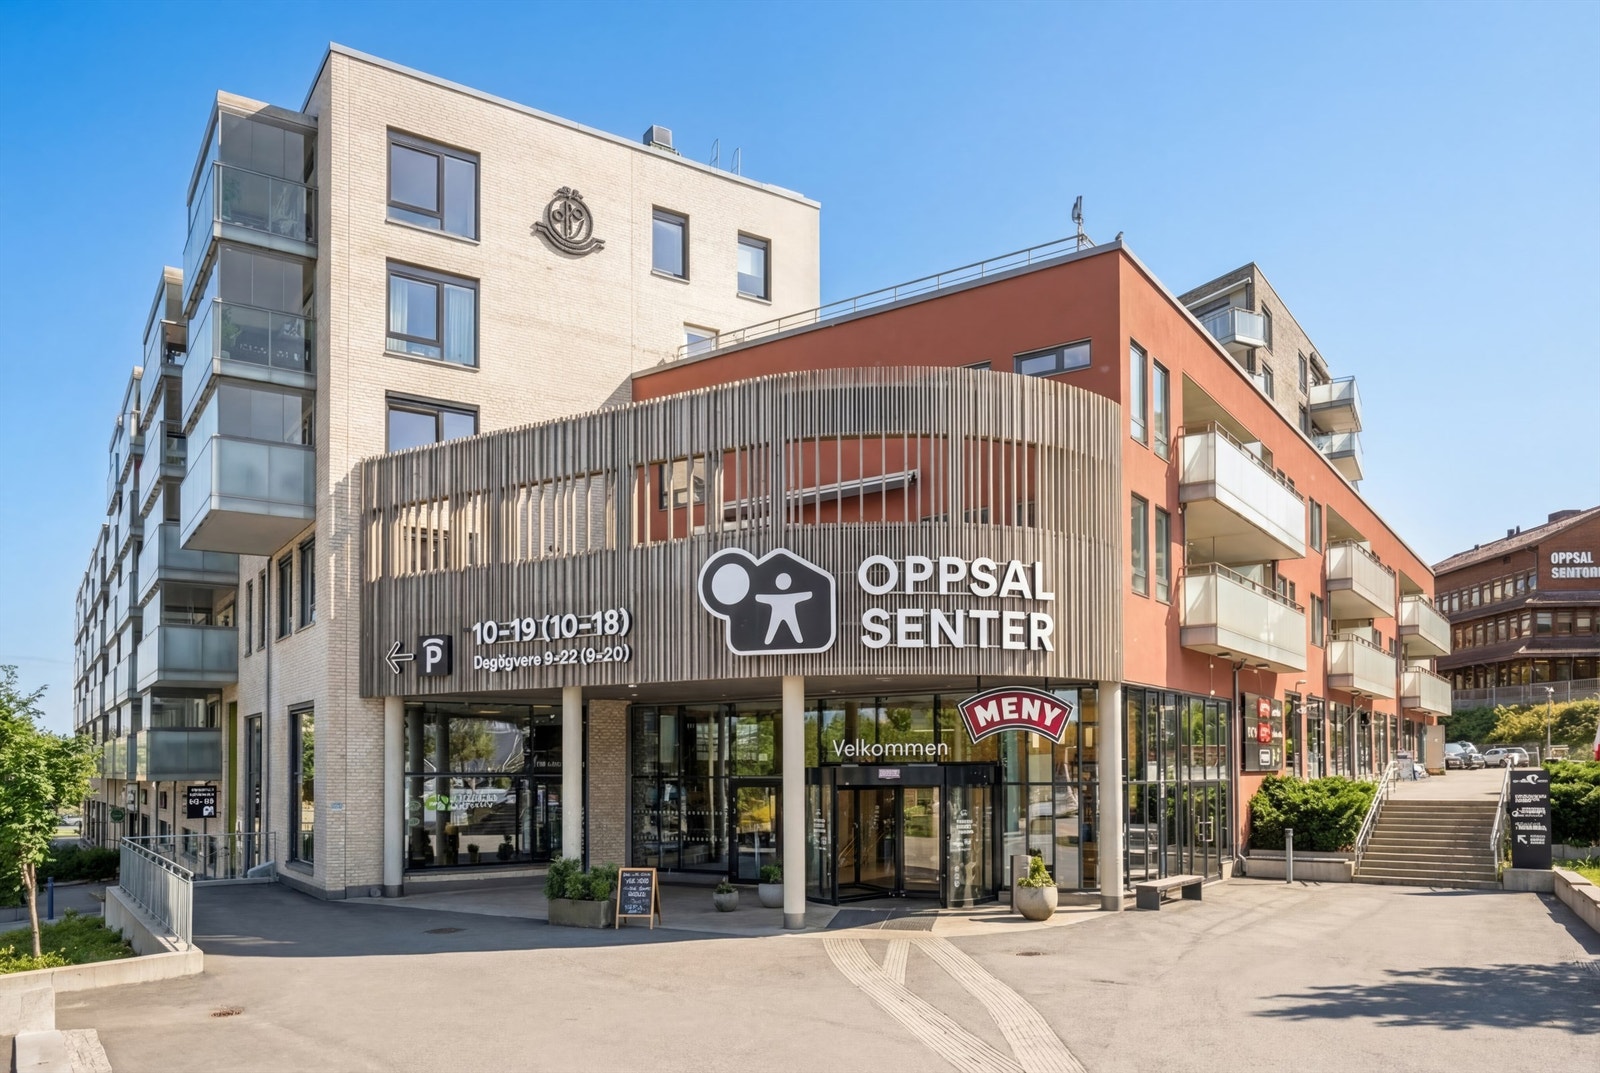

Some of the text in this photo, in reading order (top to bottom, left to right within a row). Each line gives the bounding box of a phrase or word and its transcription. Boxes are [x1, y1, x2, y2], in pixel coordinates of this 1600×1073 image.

[1551, 551, 1594, 564] OPPSAL
[858, 554, 1055, 601] OPPSAL
[1551, 566, 1600, 579] SENTOR
[861, 607, 1055, 652] SENTER
[544, 649, 578, 666] 9-22
[580, 643, 630, 666] (9-20)
[973, 696, 1062, 728] MENY
[832, 738, 948, 757] Velkommen
